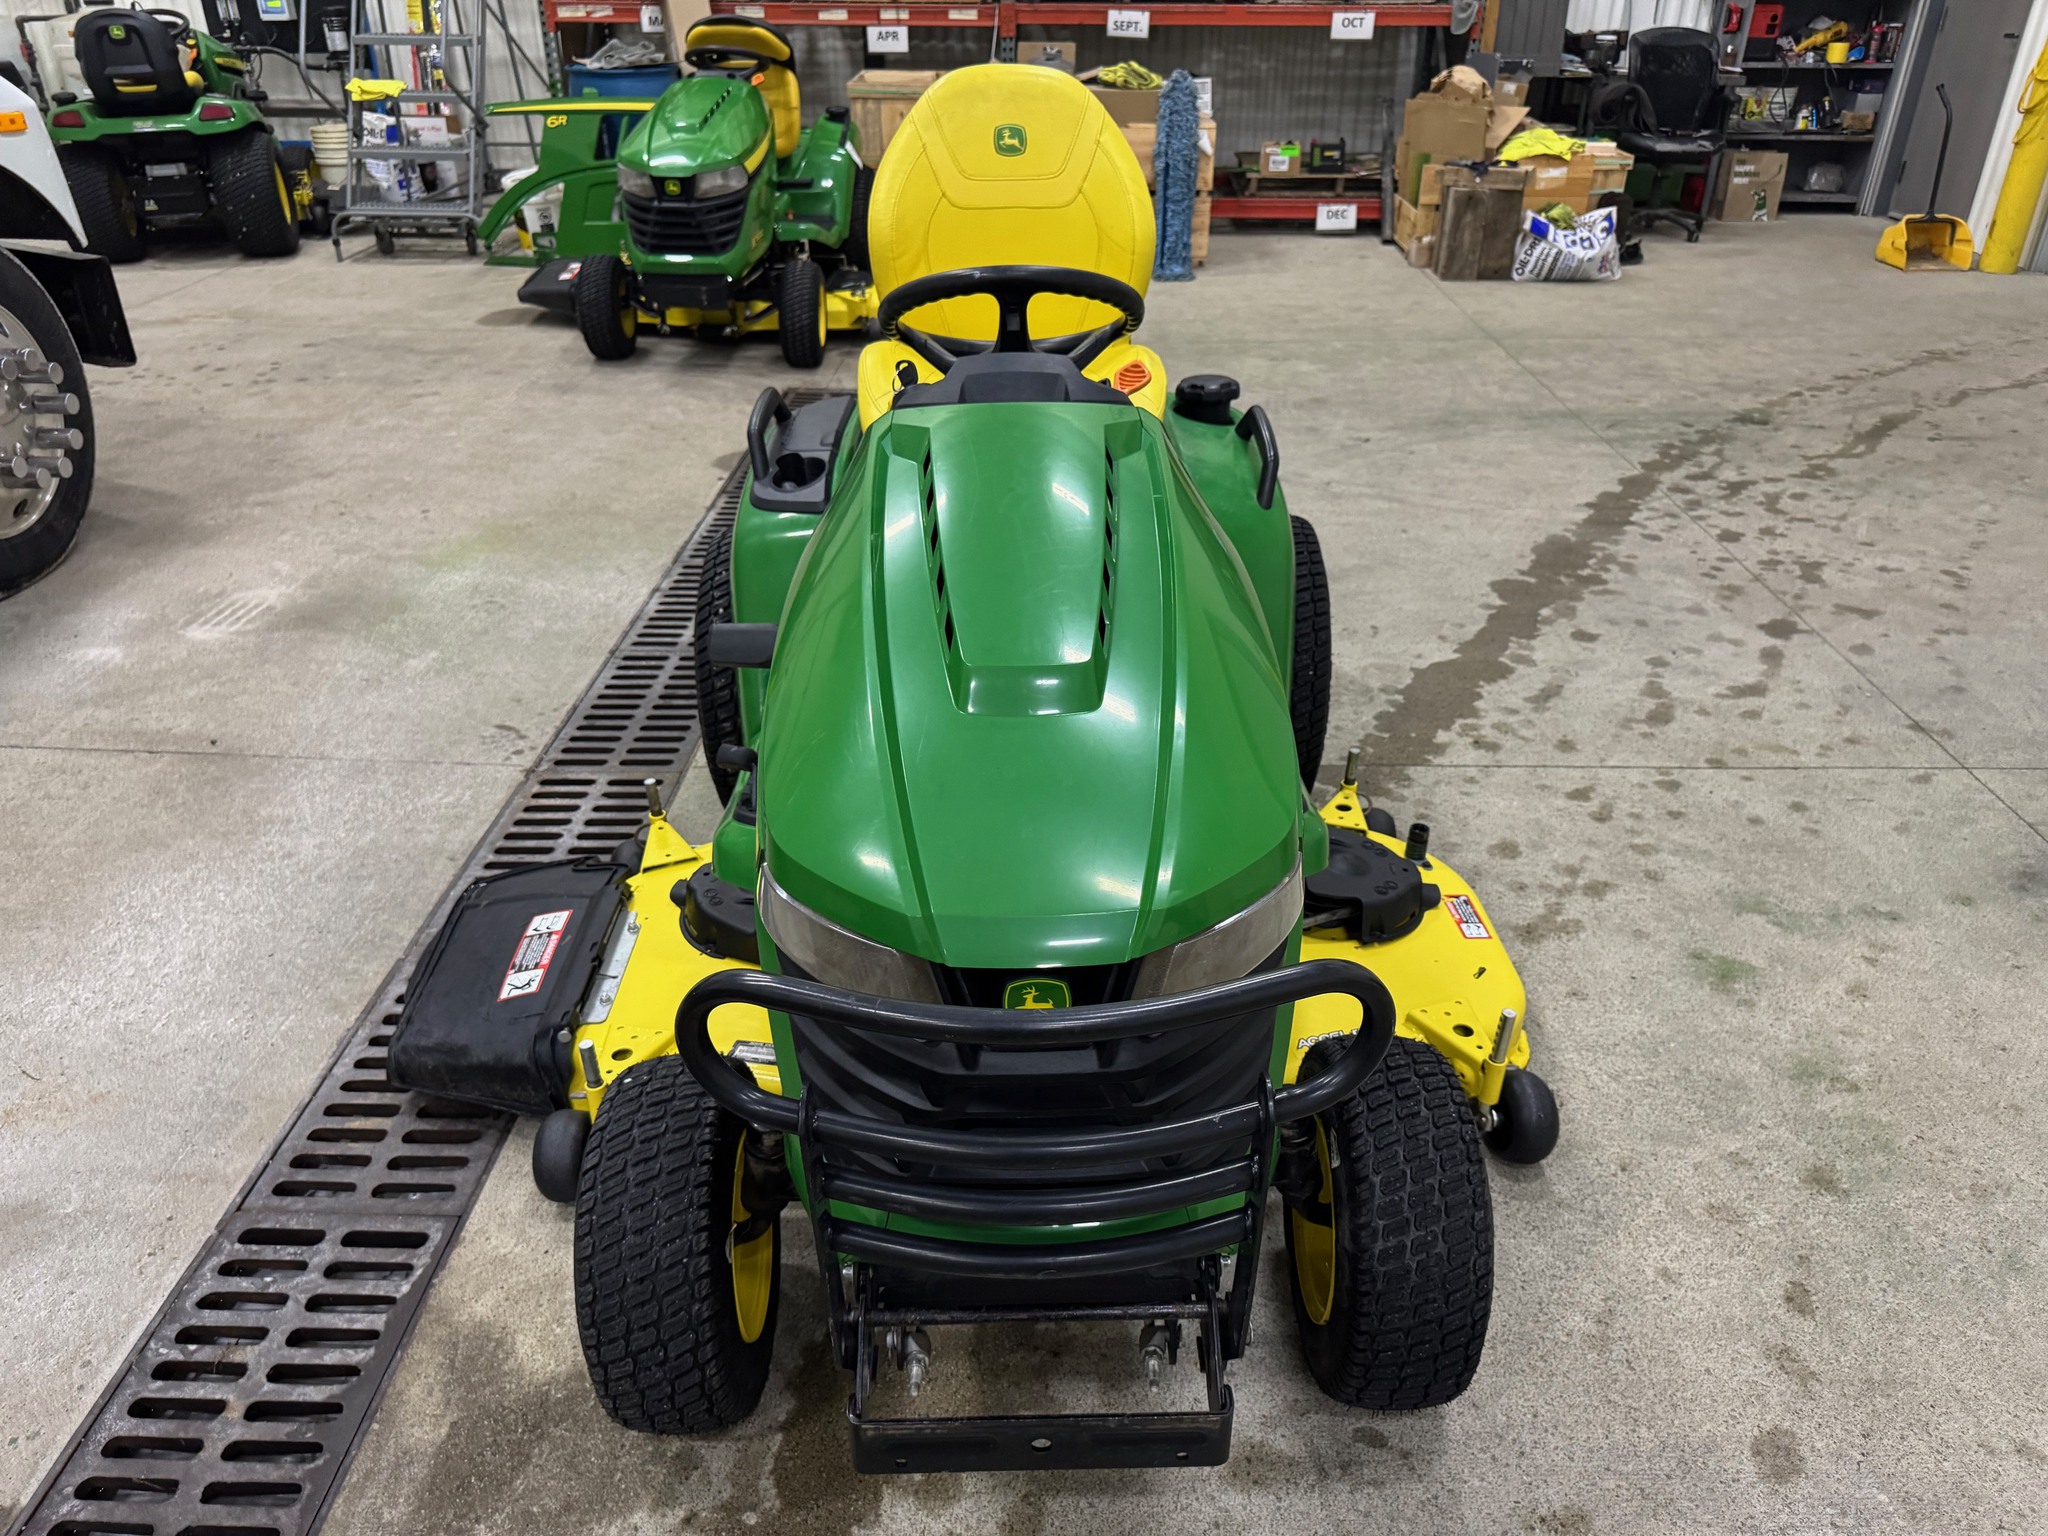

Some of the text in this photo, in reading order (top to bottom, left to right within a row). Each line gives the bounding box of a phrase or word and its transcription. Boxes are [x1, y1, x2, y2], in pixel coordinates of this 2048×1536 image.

[1112, 20, 1143, 32] SEPT.
[1341, 17, 1365, 28] OCT
[877, 31, 899, 41] APR
[546, 115, 568, 128] 6R
[1326, 209, 1348, 220] DEC
